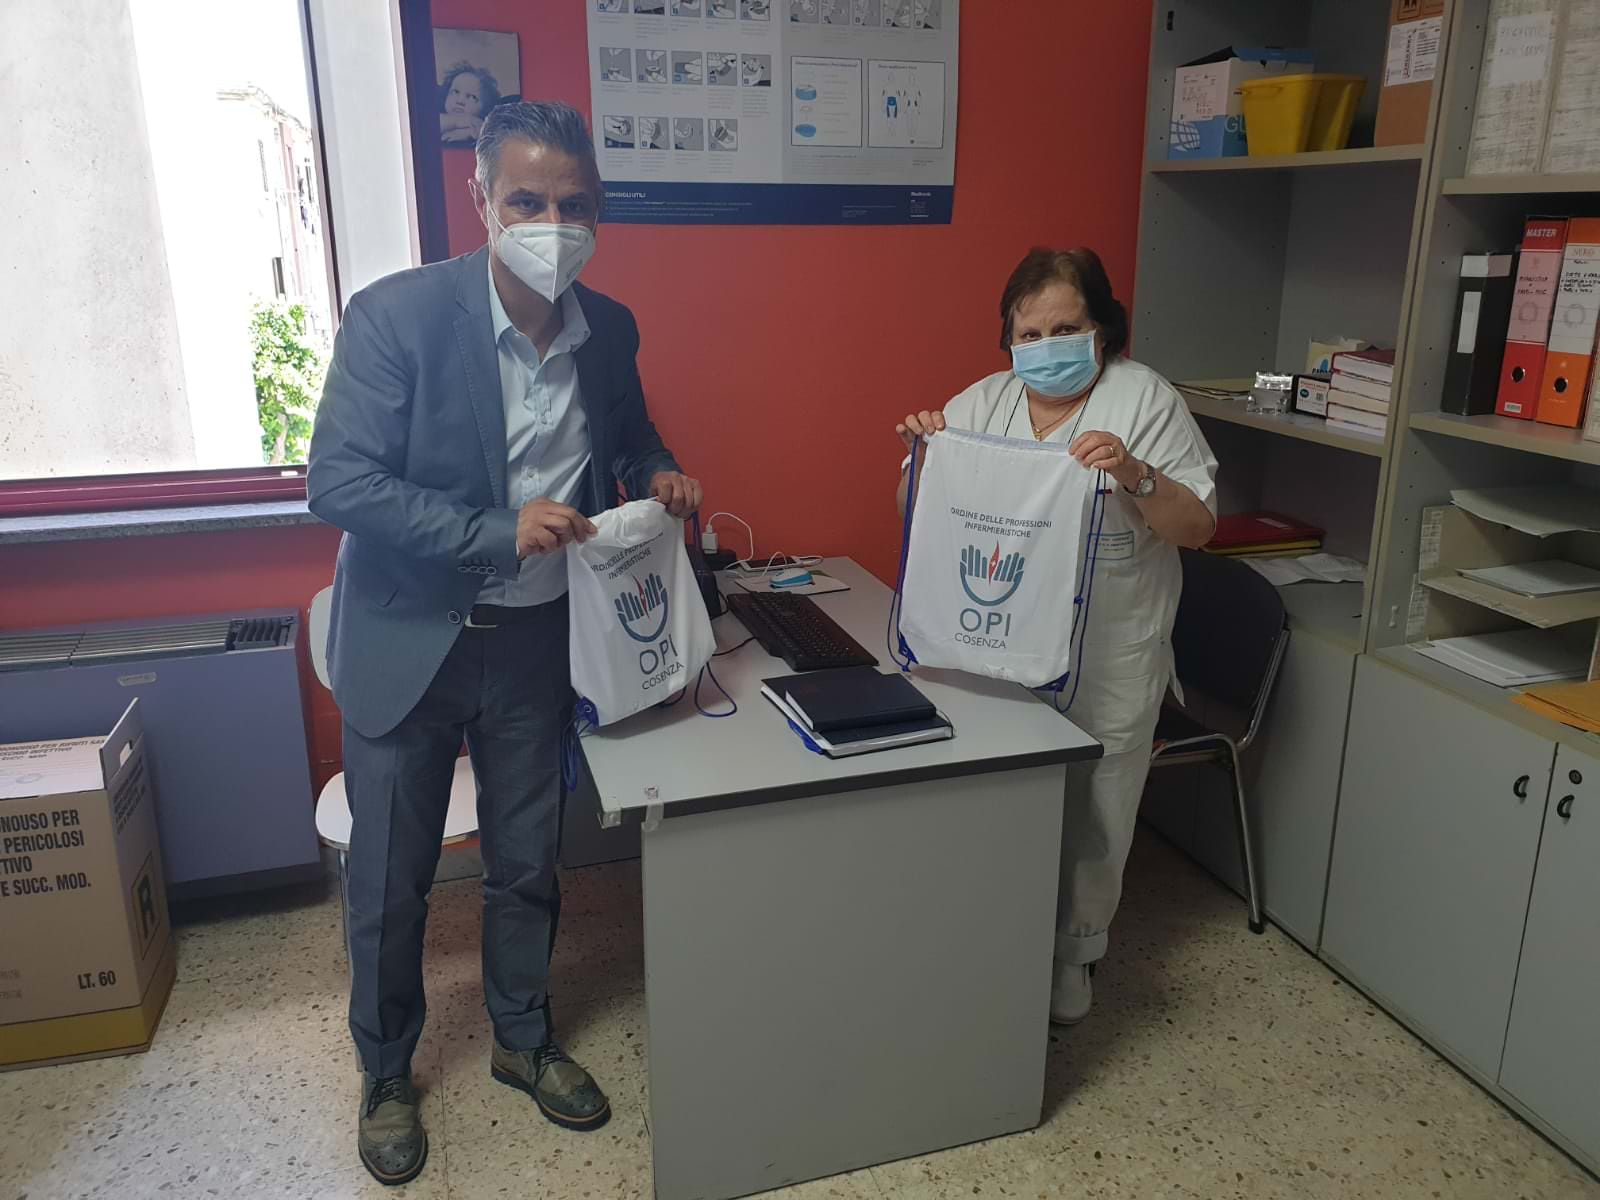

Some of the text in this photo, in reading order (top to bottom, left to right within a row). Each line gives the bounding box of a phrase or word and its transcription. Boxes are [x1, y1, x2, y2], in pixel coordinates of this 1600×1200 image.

[950, 507, 1052, 529] ORDINE DELLE PROFESSIONI
[964, 521, 1031, 538] INFERMIERISTICHE
[960, 608, 1011, 637] OPI
[954, 632, 1006, 649] COSENZA
[640, 634, 678, 675] OPI
[642, 661, 685, 690] COSENZA
[0, 809, 80, 833] NOUSO PER
[4, 830, 84, 854] PERICOLOSI
[0, 872, 91, 897] E SUCC. MOD.
[77, 970, 116, 990] LT. 60
